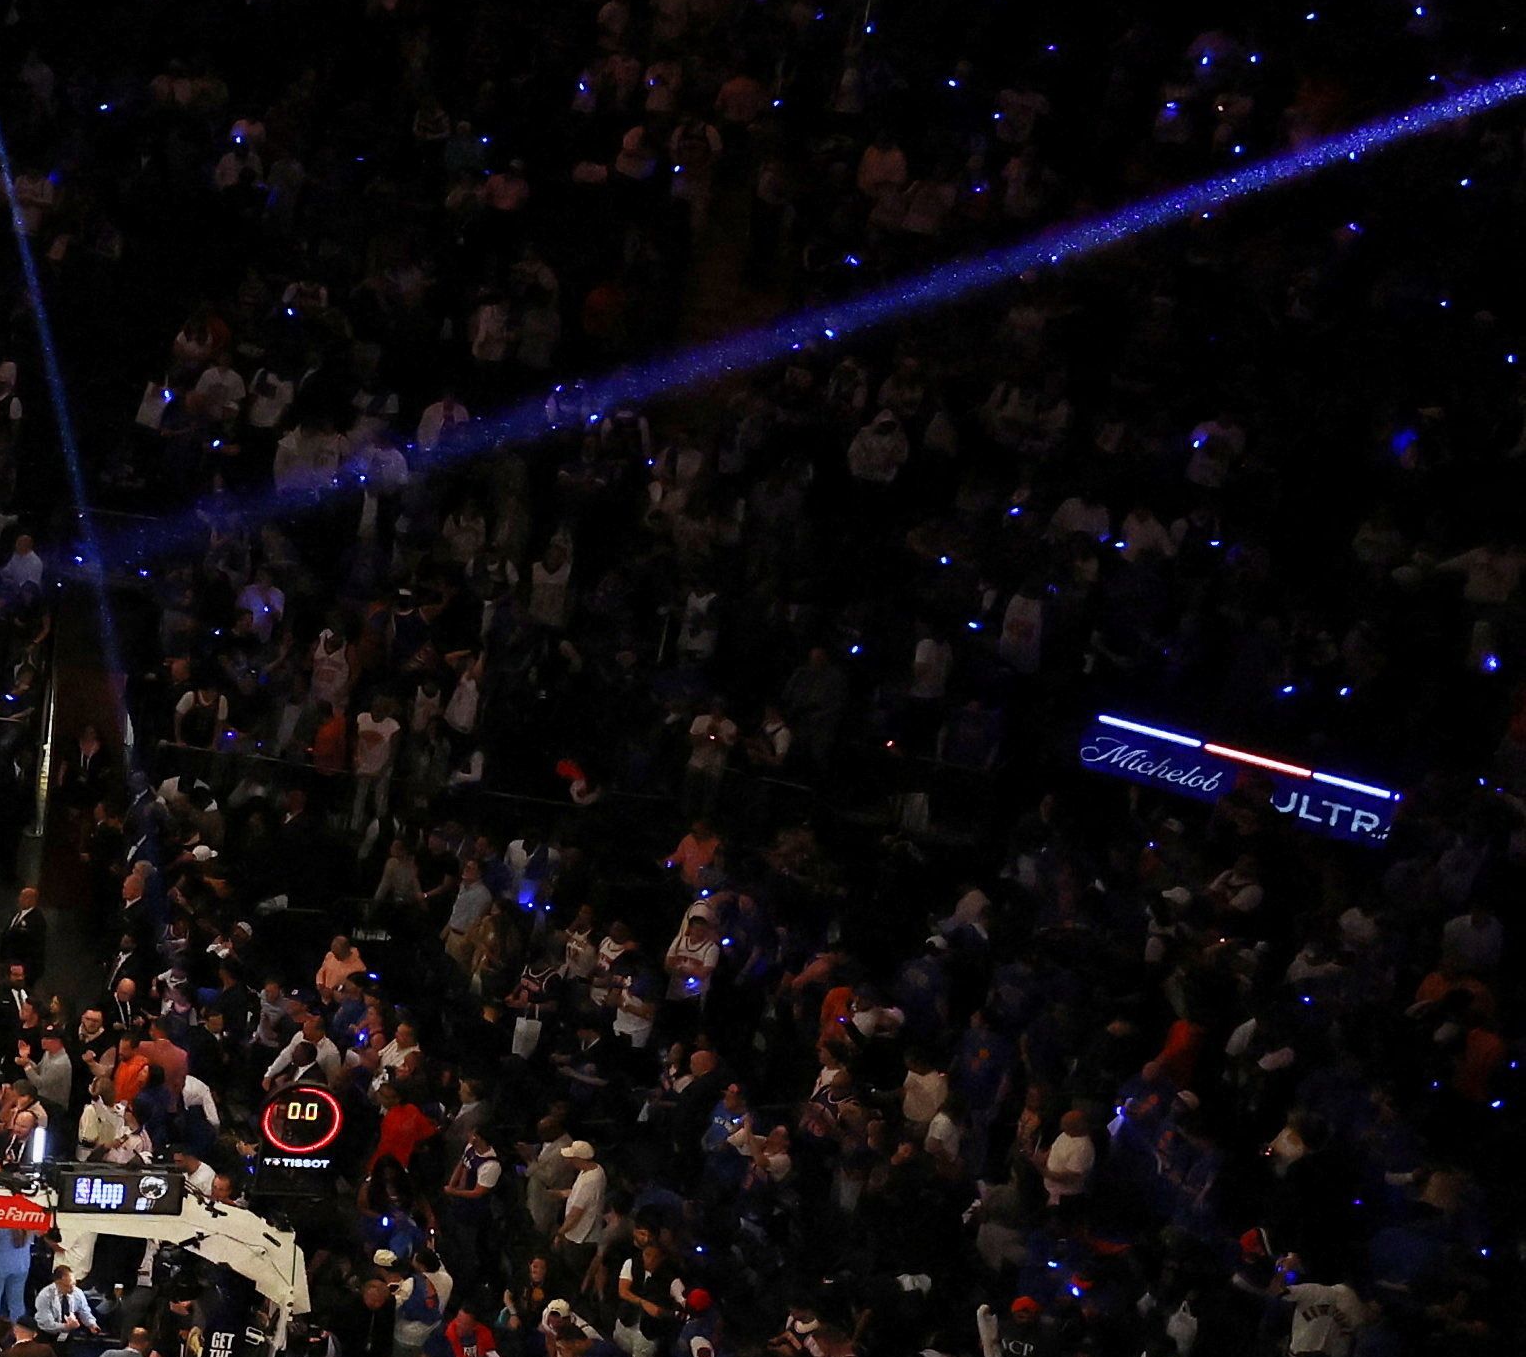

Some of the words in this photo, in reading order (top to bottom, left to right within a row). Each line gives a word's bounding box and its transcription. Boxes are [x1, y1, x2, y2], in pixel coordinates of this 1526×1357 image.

[1080, 741, 1222, 793] Michelob
[1274, 791, 1391, 837] ULTR
[287, 1102, 319, 1121] 0.0
[282, 1157, 330, 1169] TISSOT
[89, 1179, 125, 1209] App
[211, 1331, 236, 1349] GET
